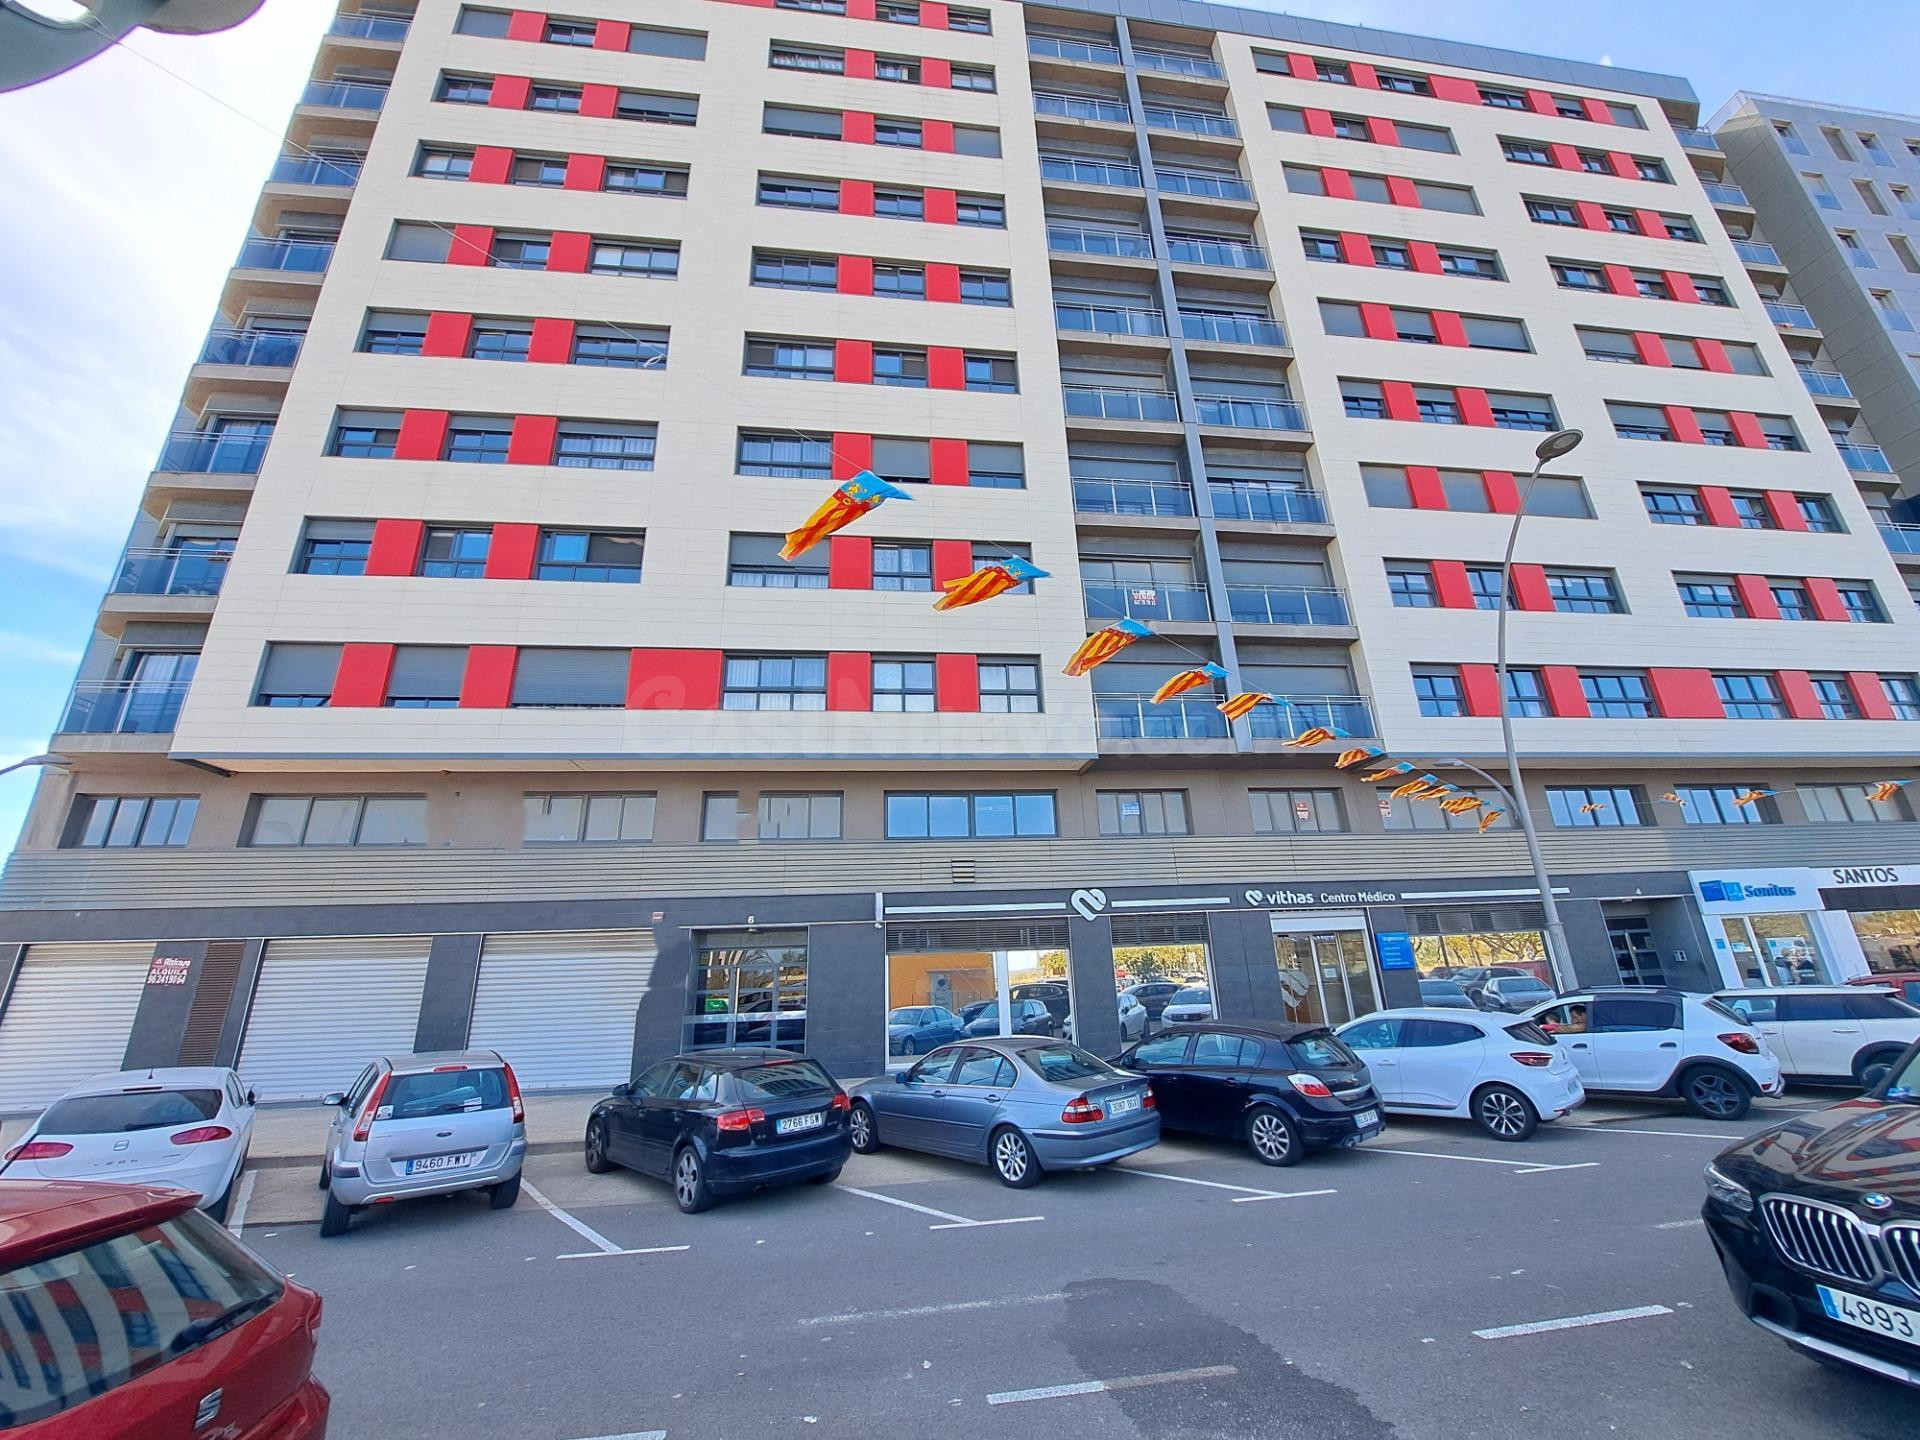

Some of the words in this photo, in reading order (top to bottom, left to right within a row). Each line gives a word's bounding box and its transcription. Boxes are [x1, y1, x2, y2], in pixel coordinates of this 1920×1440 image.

[1833, 867, 1899, 884] SANTOS
[1266, 890, 1314, 904] vithas
[1320, 892, 1356, 903] Centro
[1358, 890, 1396, 902] Médico
[1635, 887, 1642, 895] 4
[1743, 883, 1796, 898] Sanitas
[747, 915, 755, 924] 6
[782, 1117, 803, 1130] 2766
[804, 1114, 820, 1125] FSW
[415, 1157, 444, 1170] 9460
[446, 1154, 469, 1167] FWY
[1841, 1295, 1914, 1337] 4893
